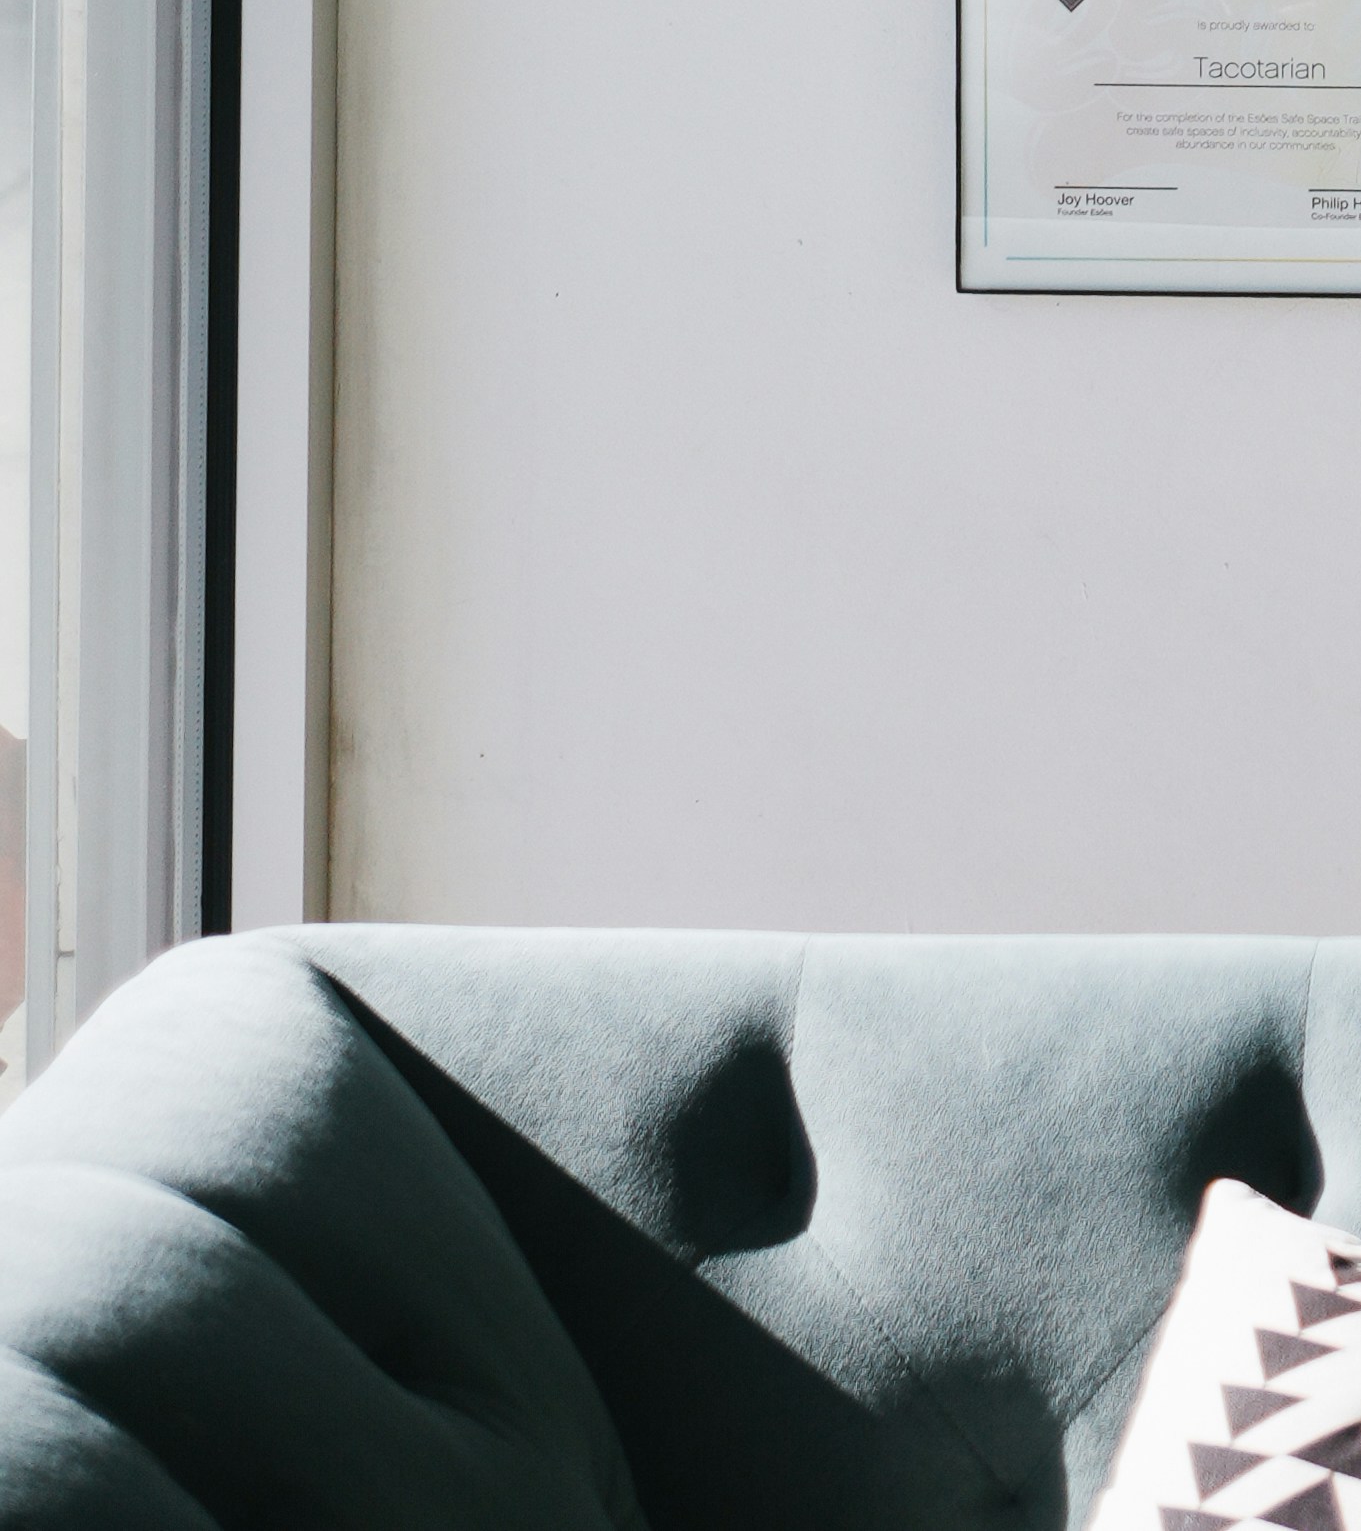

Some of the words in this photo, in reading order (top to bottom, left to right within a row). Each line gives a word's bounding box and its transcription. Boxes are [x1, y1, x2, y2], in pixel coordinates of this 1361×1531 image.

[1210, 20, 1250, 32] proudly
[1252, 21, 1301, 32] awarded
[1194, 57, 1325, 79] Tacotarian
[1058, 193, 1081, 208] Joy
[1086, 193, 1134, 205] Hoover
[1312, 197, 1348, 211] Philip
